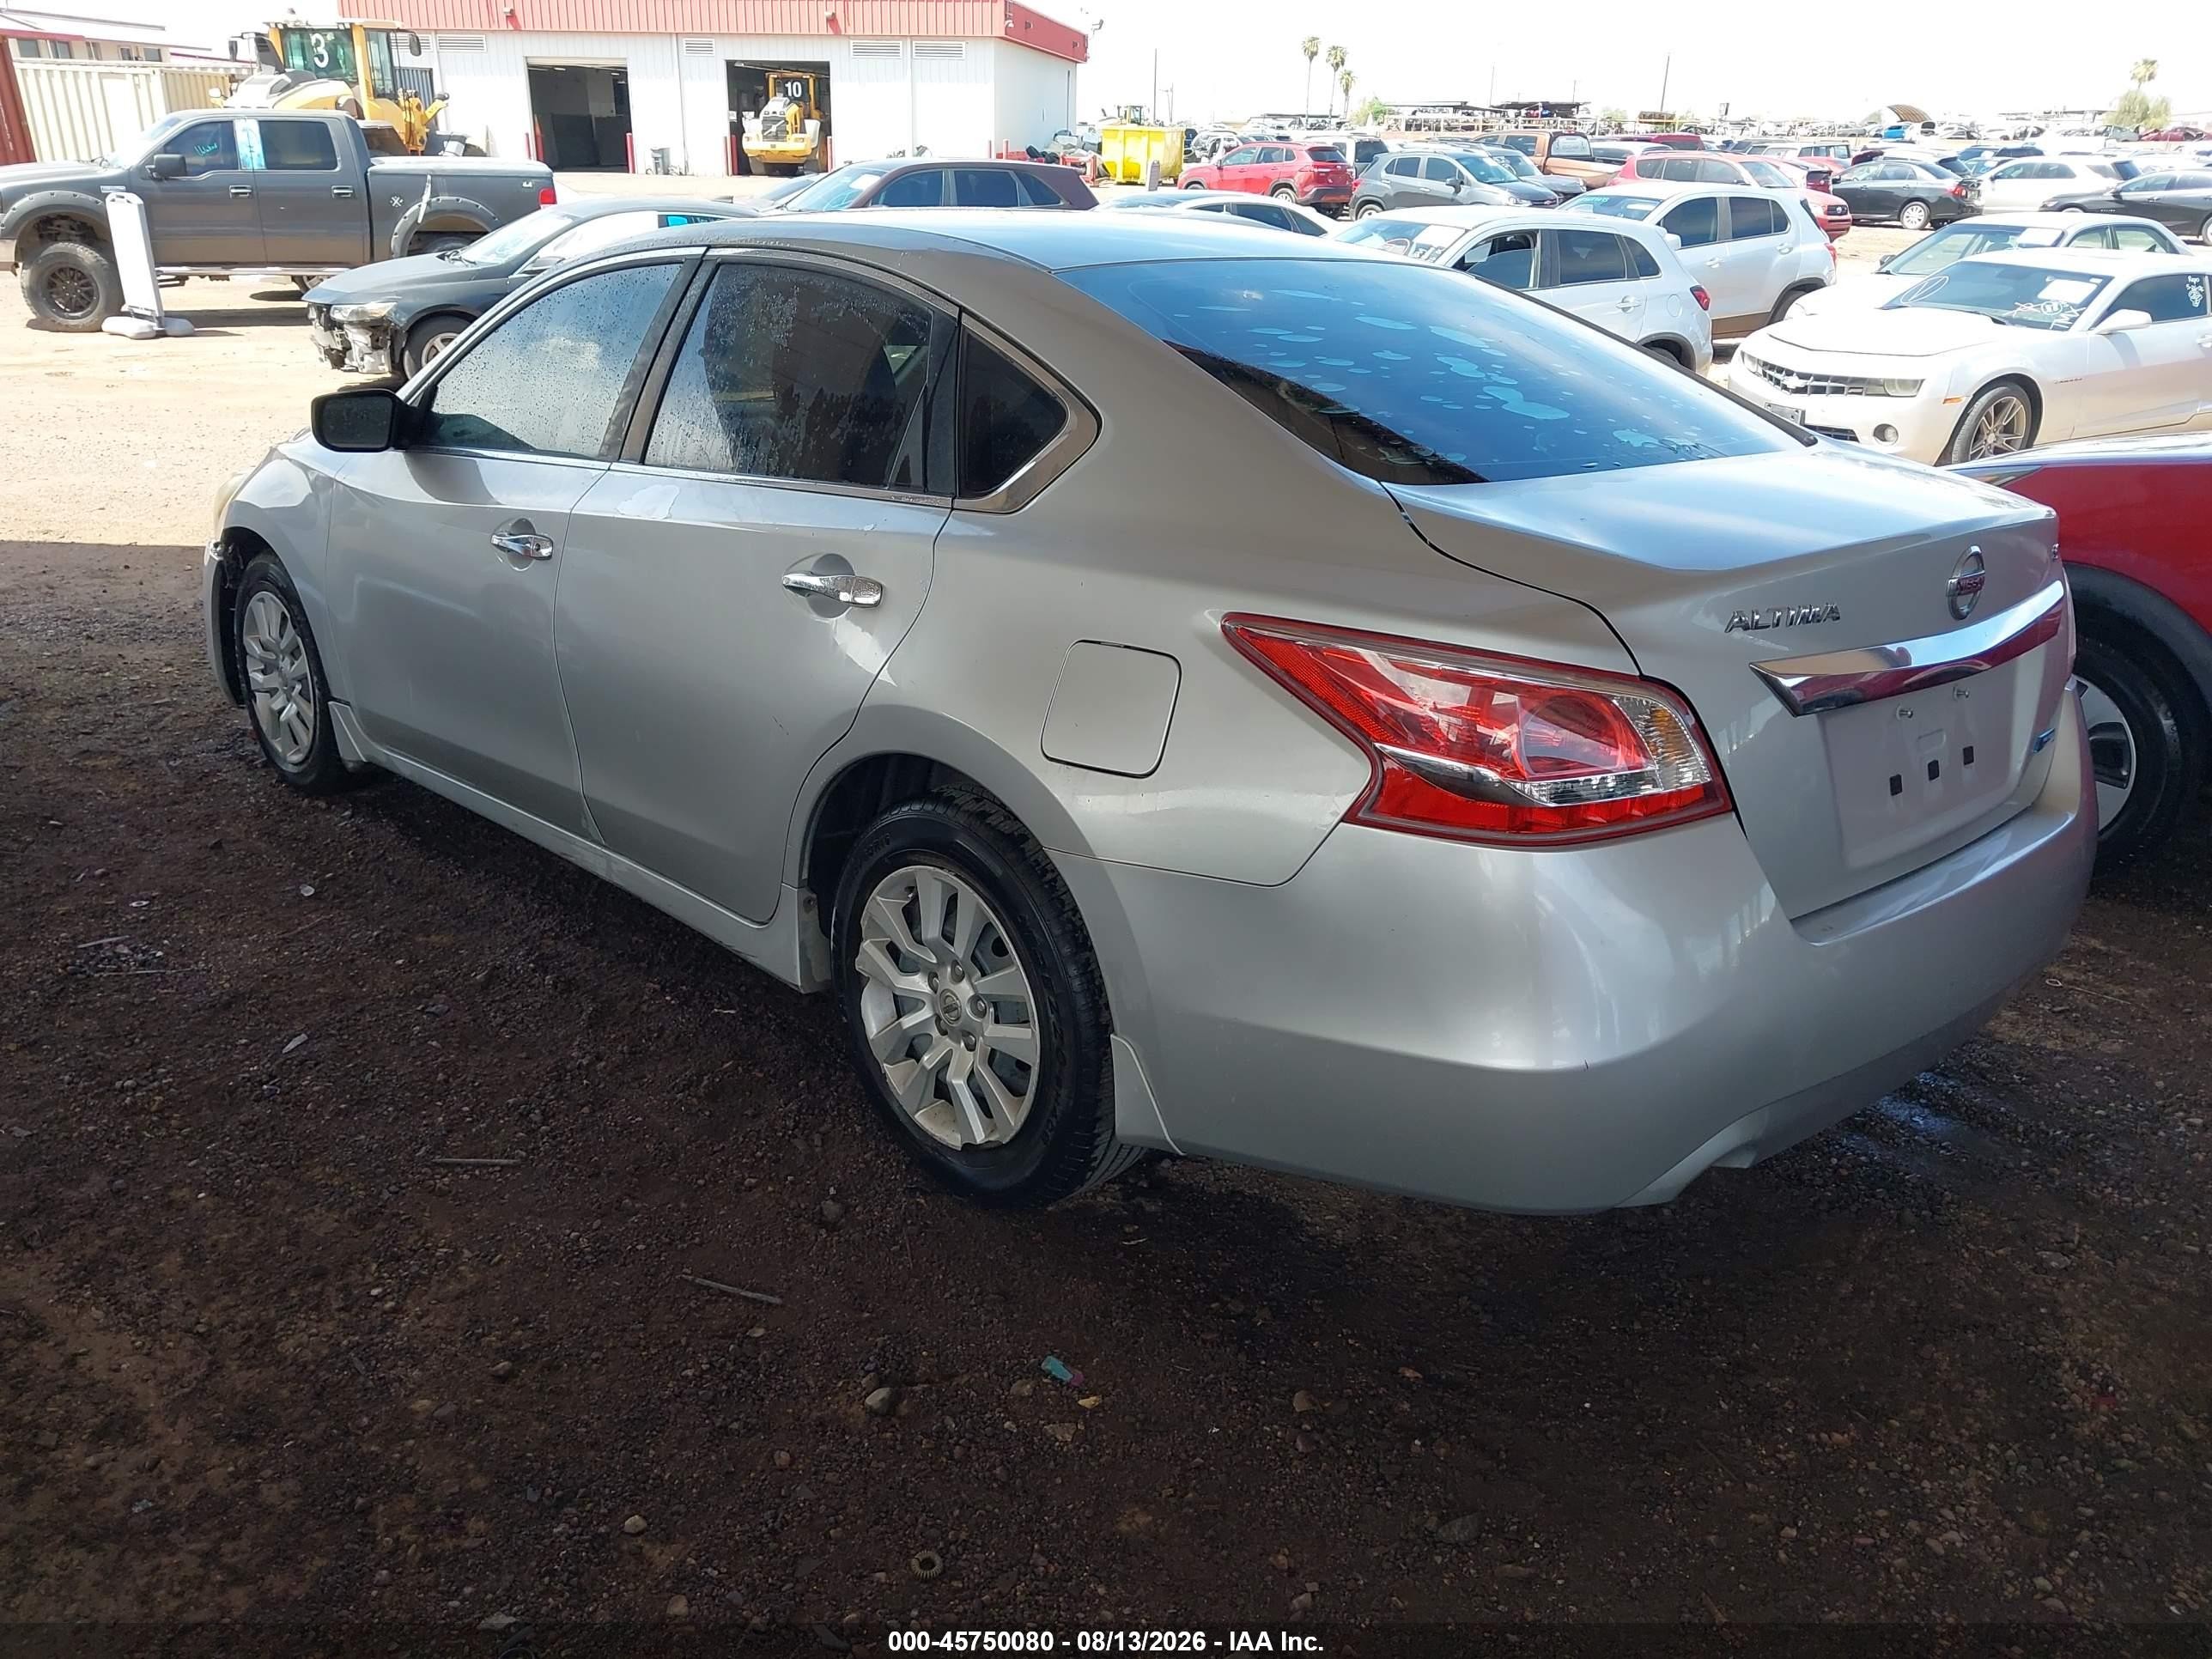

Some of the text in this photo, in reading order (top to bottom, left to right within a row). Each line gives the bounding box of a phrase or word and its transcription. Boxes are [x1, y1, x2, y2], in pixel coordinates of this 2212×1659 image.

[309, 33, 330, 69] 3
[784, 81, 803, 98] 10
[1723, 601, 1841, 634] ALTIMA
